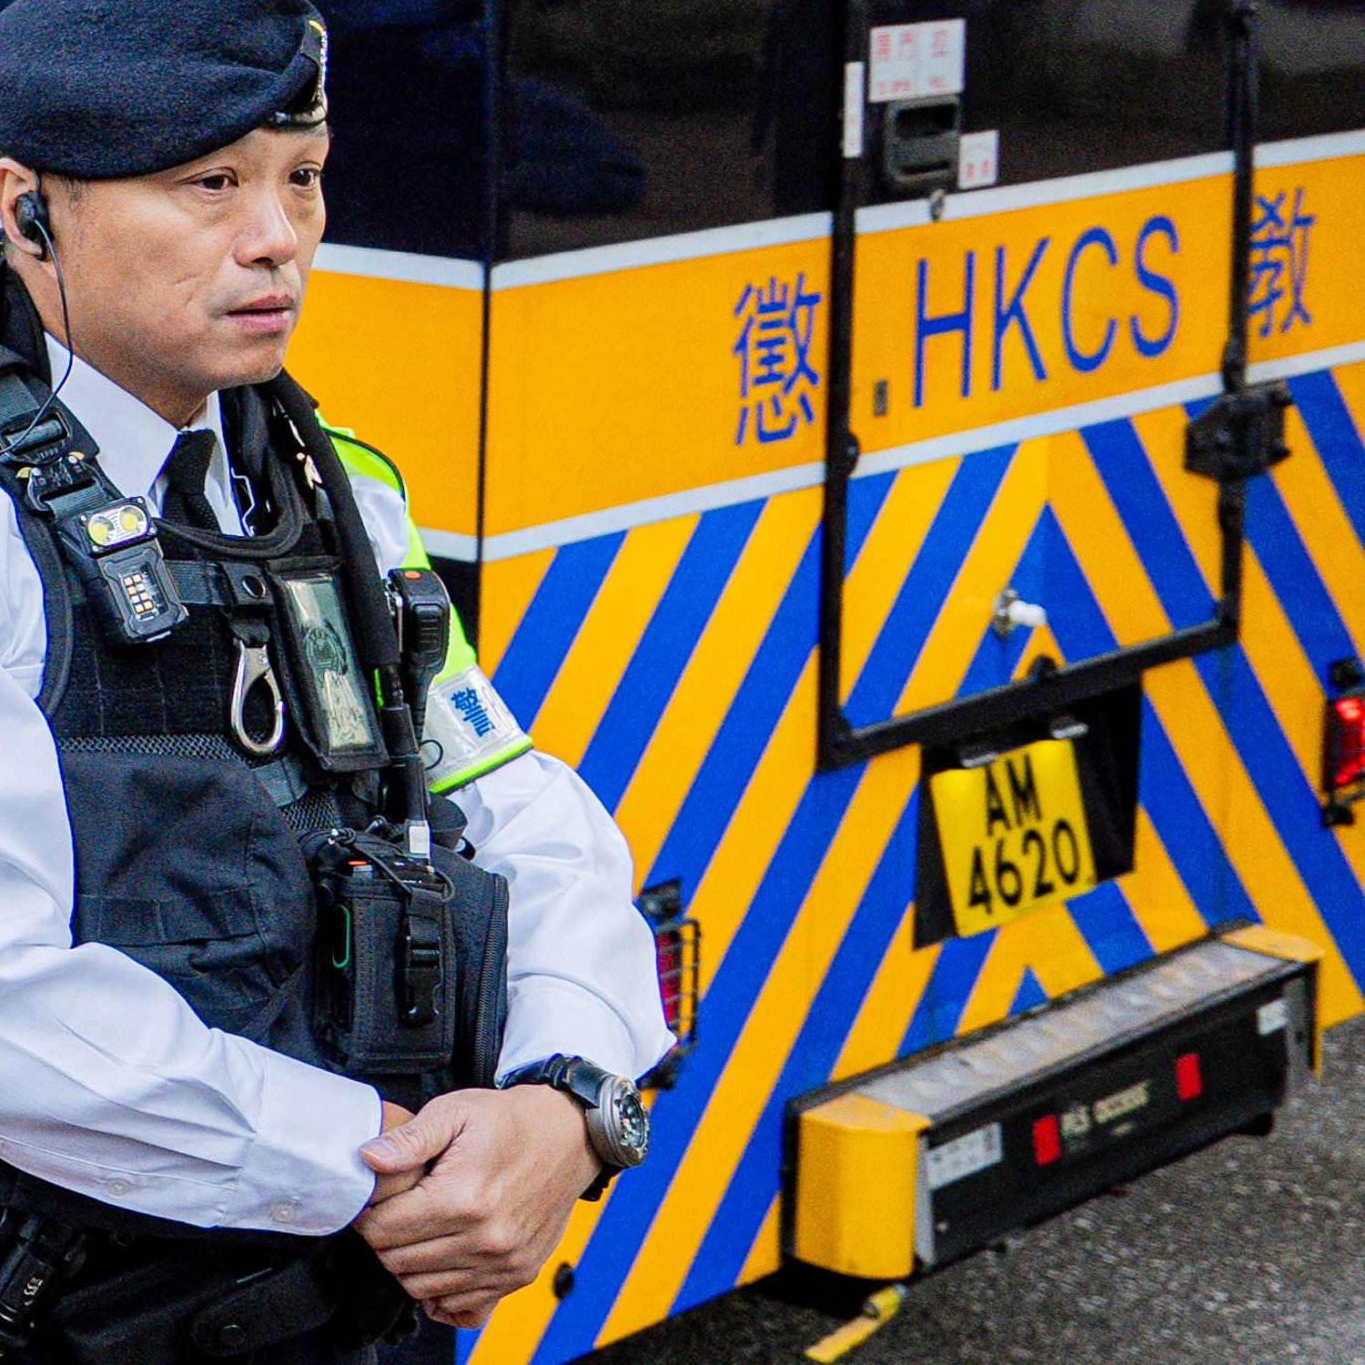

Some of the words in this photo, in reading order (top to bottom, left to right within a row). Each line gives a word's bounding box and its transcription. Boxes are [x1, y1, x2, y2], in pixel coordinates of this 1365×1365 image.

[911, 215, 1181, 409] HKCS
[984, 752, 1044, 838] AM
[967, 817, 1082, 916] 4620
